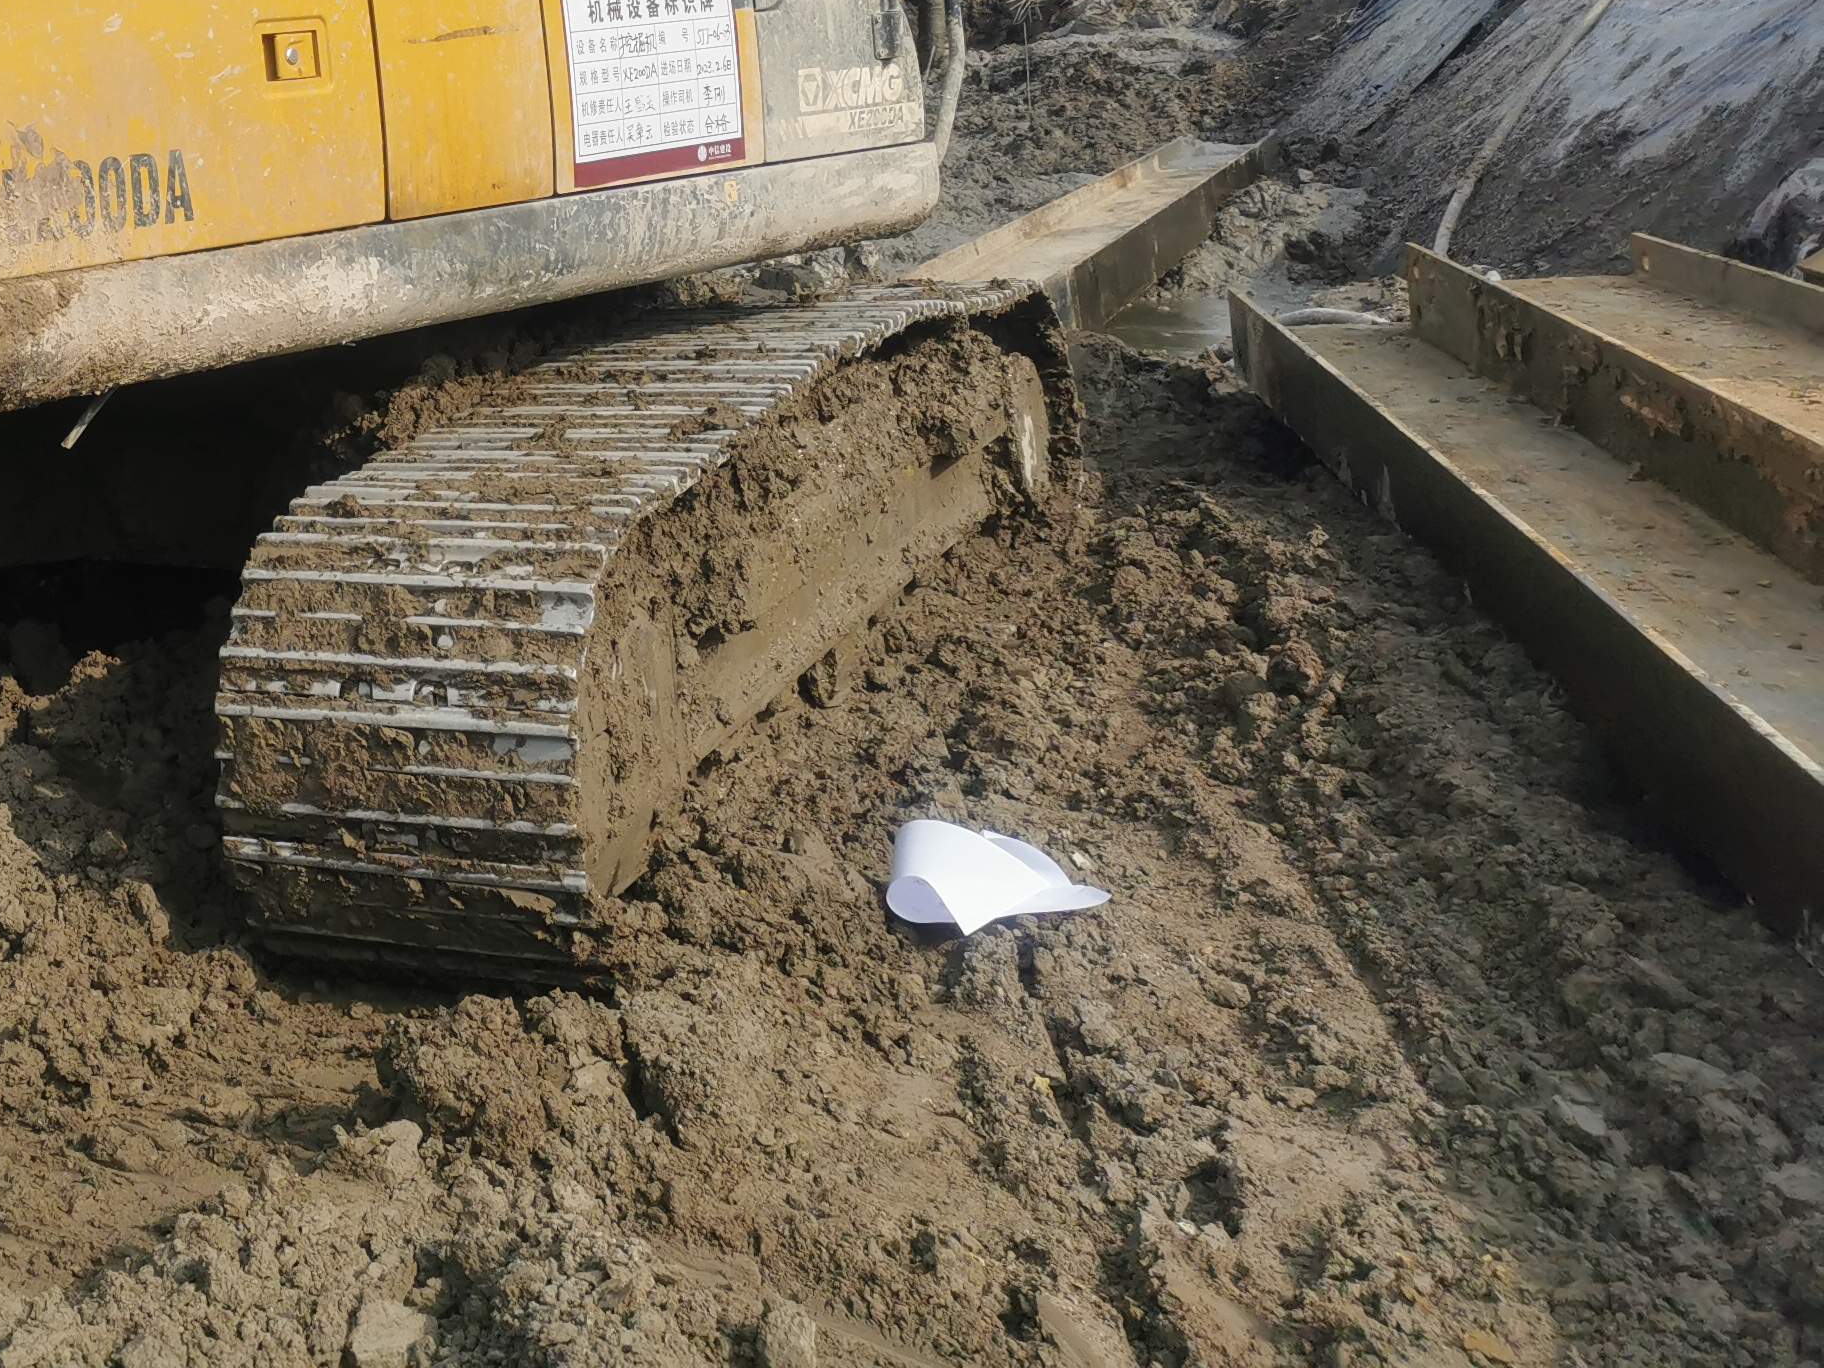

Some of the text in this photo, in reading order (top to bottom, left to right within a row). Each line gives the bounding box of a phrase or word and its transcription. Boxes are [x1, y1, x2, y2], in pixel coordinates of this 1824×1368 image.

[576, 35, 617, 56] 设备名称
[579, 66, 620, 87] 规格型号
[822, 63, 904, 109] XCMG
[704, 113, 731, 134] 合格
